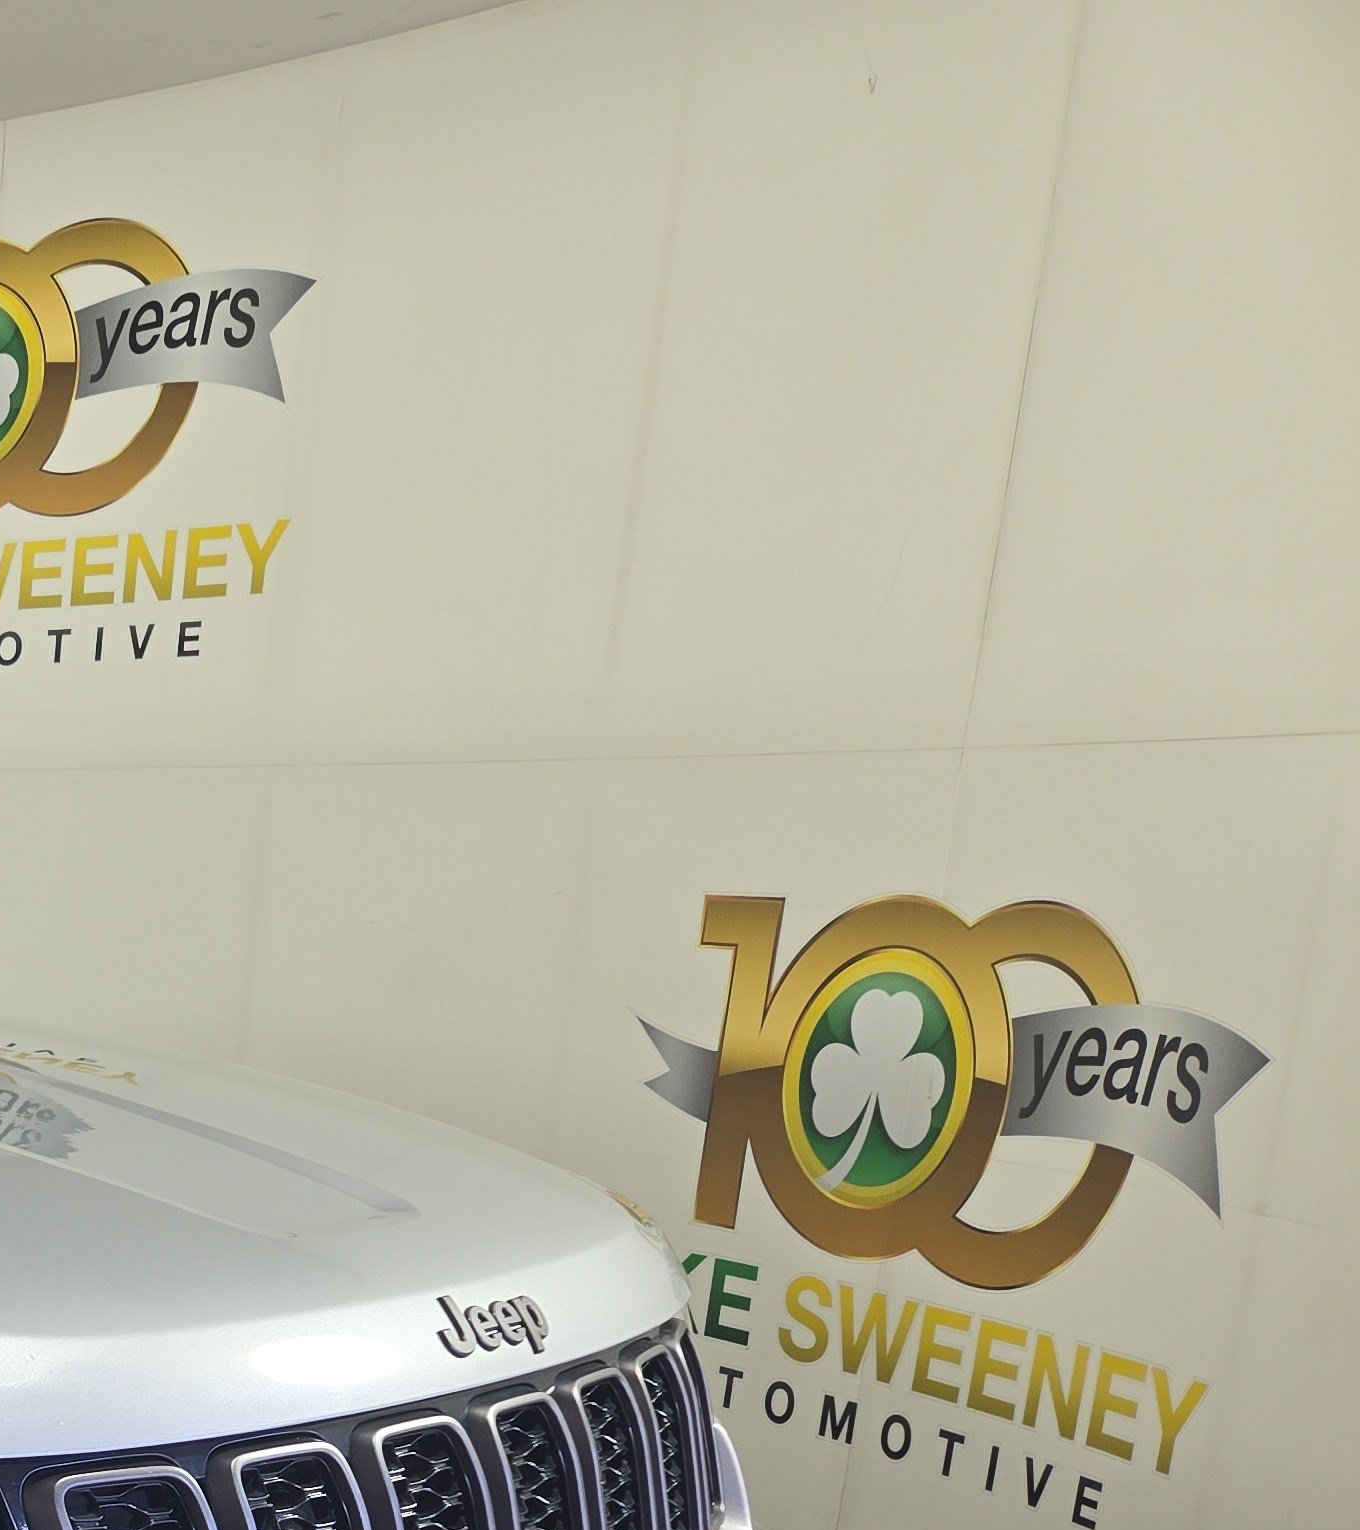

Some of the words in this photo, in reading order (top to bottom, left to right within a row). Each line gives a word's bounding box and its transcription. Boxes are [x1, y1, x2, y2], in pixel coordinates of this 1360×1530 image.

[90, 287, 260, 384] years
[694, 894, 1140, 1291] 100
[1019, 1025, 1209, 1124] years
[436, 1295, 549, 1358] Jeep
[778, 1275, 1208, 1476] SWEENEY
[717, 1366, 1104, 1530] TOMOTIVE
